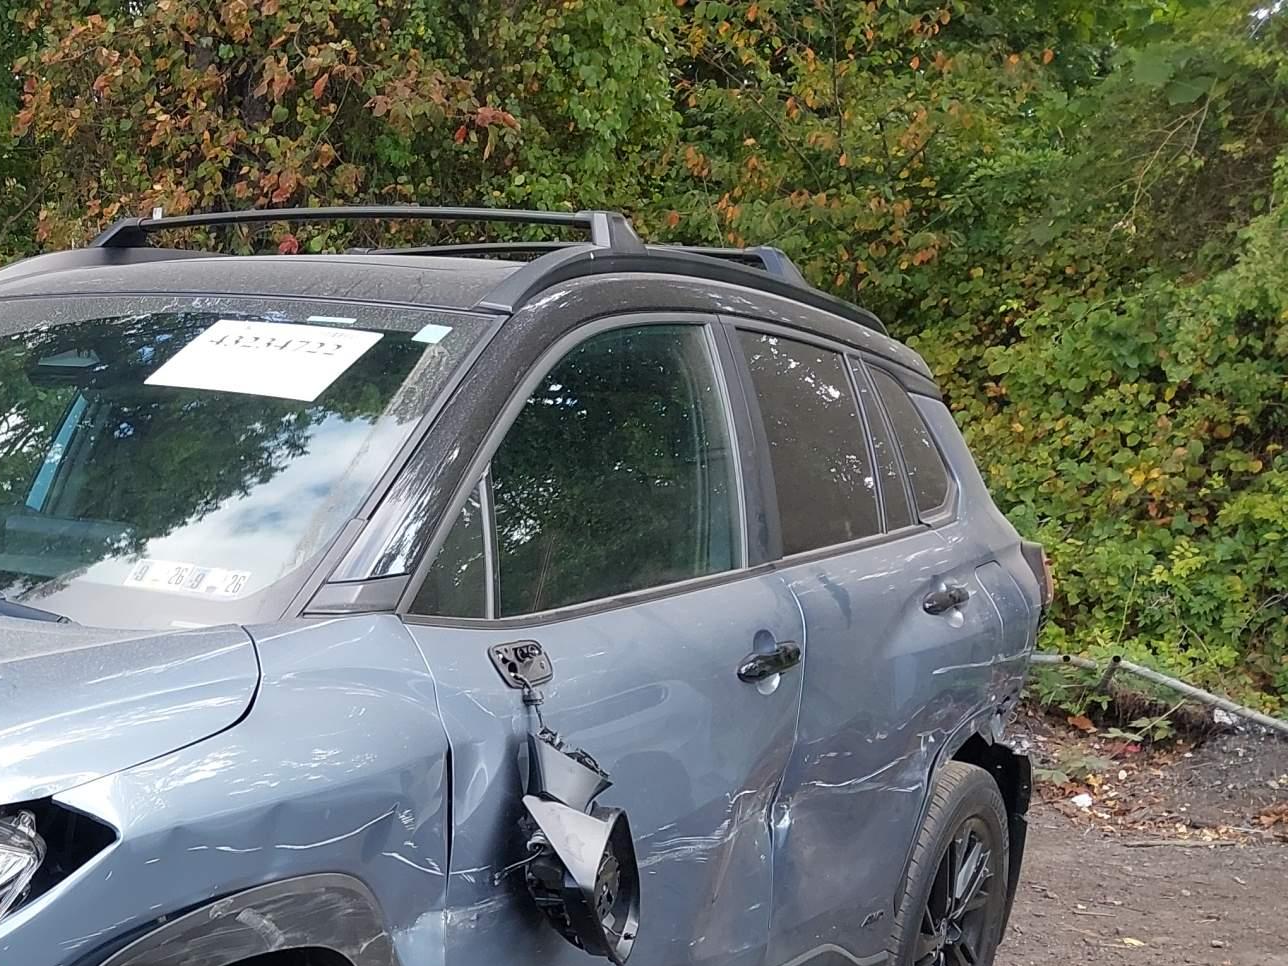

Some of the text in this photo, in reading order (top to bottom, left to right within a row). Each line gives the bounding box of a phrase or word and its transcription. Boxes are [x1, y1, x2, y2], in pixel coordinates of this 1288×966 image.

[208, 334, 344, 356] 43234722
[168, 566, 189, 585] 26
[224, 574, 247, 593] 26
